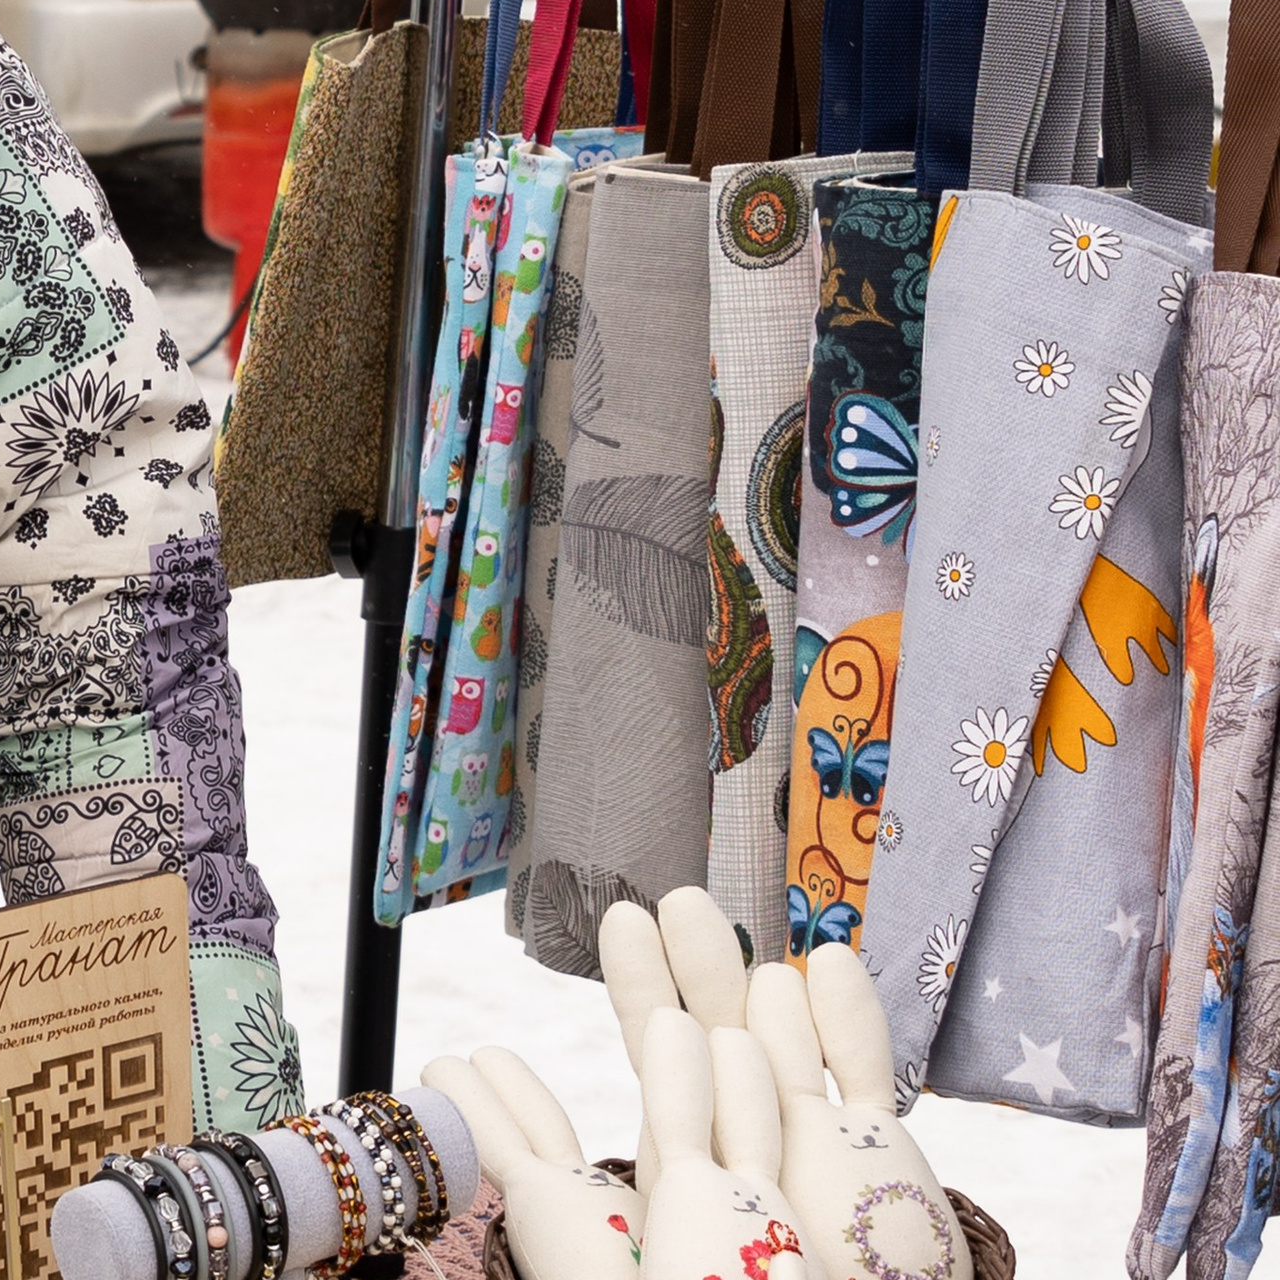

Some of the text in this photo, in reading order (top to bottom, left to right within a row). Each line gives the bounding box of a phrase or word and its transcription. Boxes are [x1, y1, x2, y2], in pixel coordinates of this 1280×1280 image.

[30, 907, 163, 949] Мастерская
[10, 998, 111, 1032] натурального
[114, 986, 163, 1008] камня,
[47, 1019, 97, 1042] ручной
[99, 1004, 156, 1030] работы
